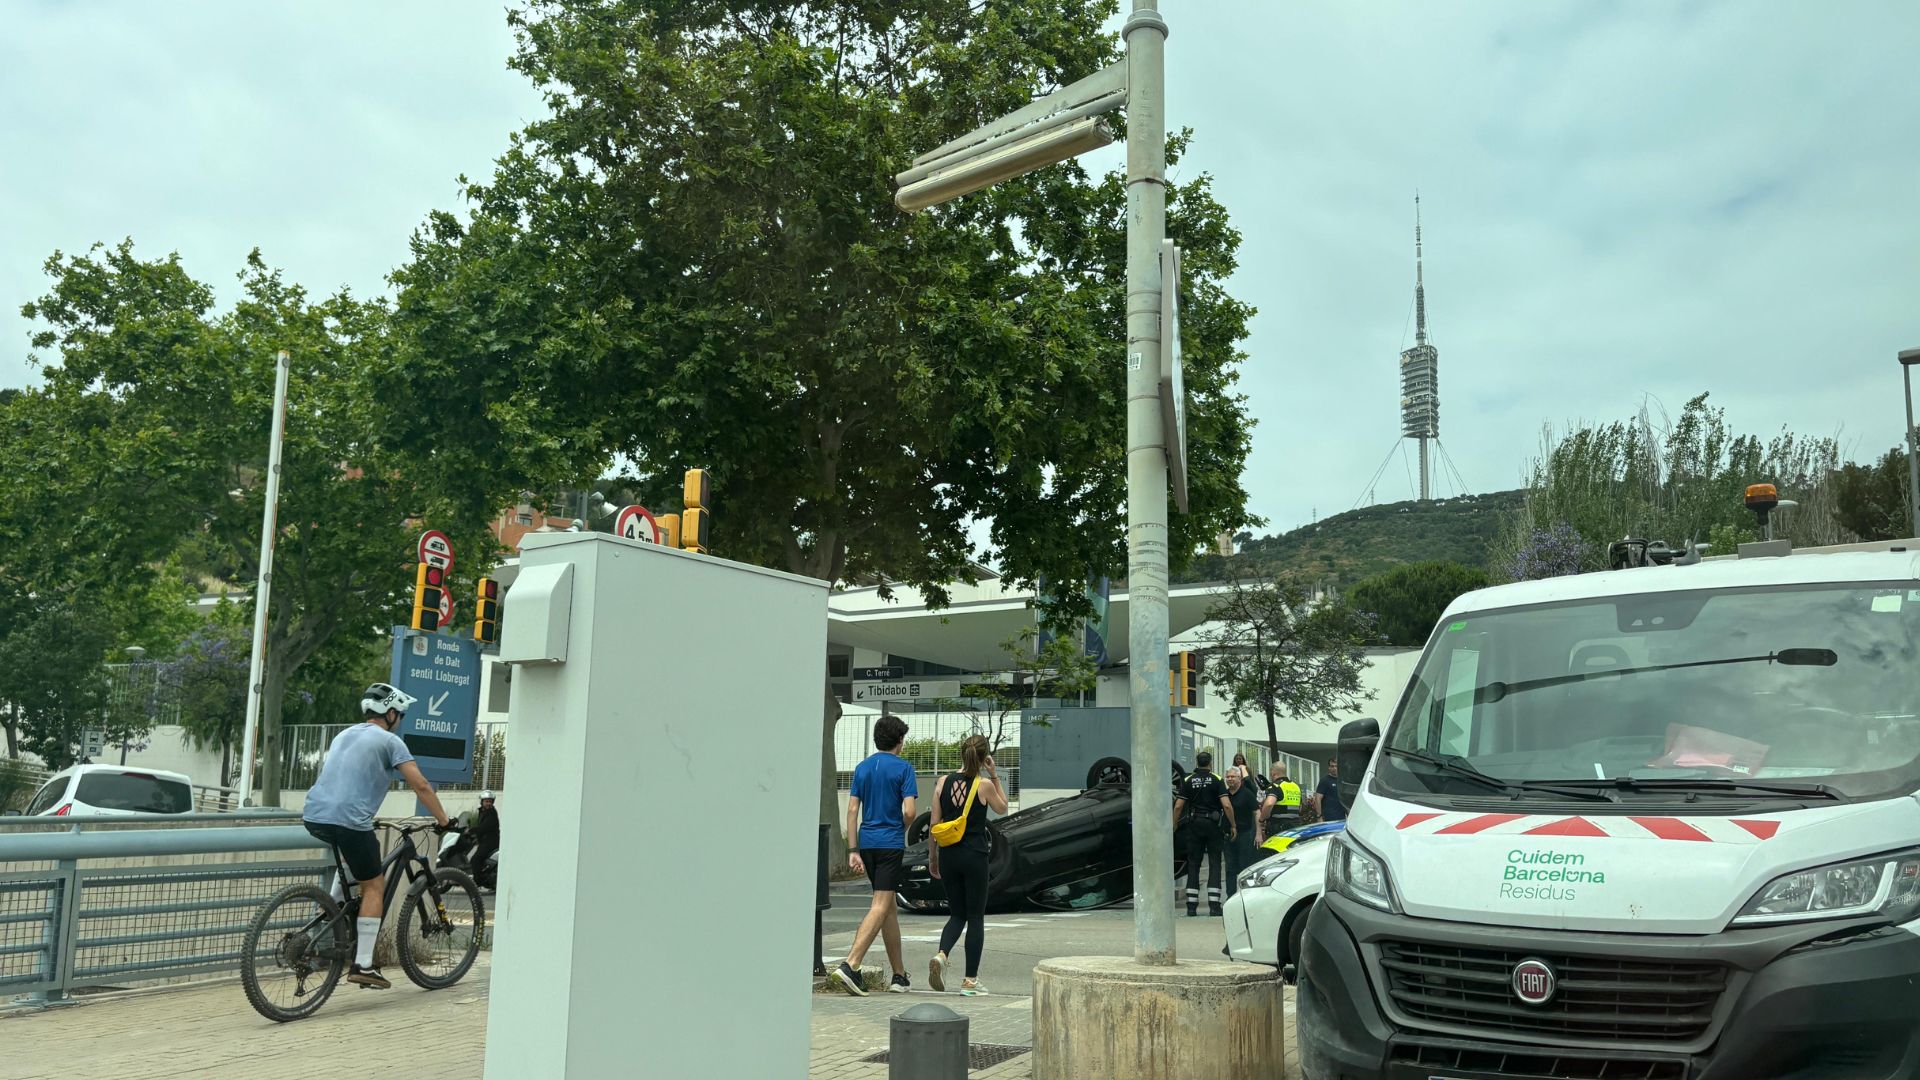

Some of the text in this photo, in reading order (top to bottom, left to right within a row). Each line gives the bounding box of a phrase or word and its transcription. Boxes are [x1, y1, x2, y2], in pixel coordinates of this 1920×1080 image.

[437, 639, 460, 652] Ronda
[434, 654, 460, 668] de Dalt
[410, 668, 470, 686] sentit Llobregat
[866, 668, 890, 677] C. Terré
[868, 684, 907, 696] Tibidabo
[415, 718, 458, 734] ENTRADA 7
[1507, 849, 1585, 865] Cuidem
[1503, 865, 1605, 884] Barcelona
[1499, 882, 1576, 901] Residus
[1522, 973, 1545, 993] FIAT
